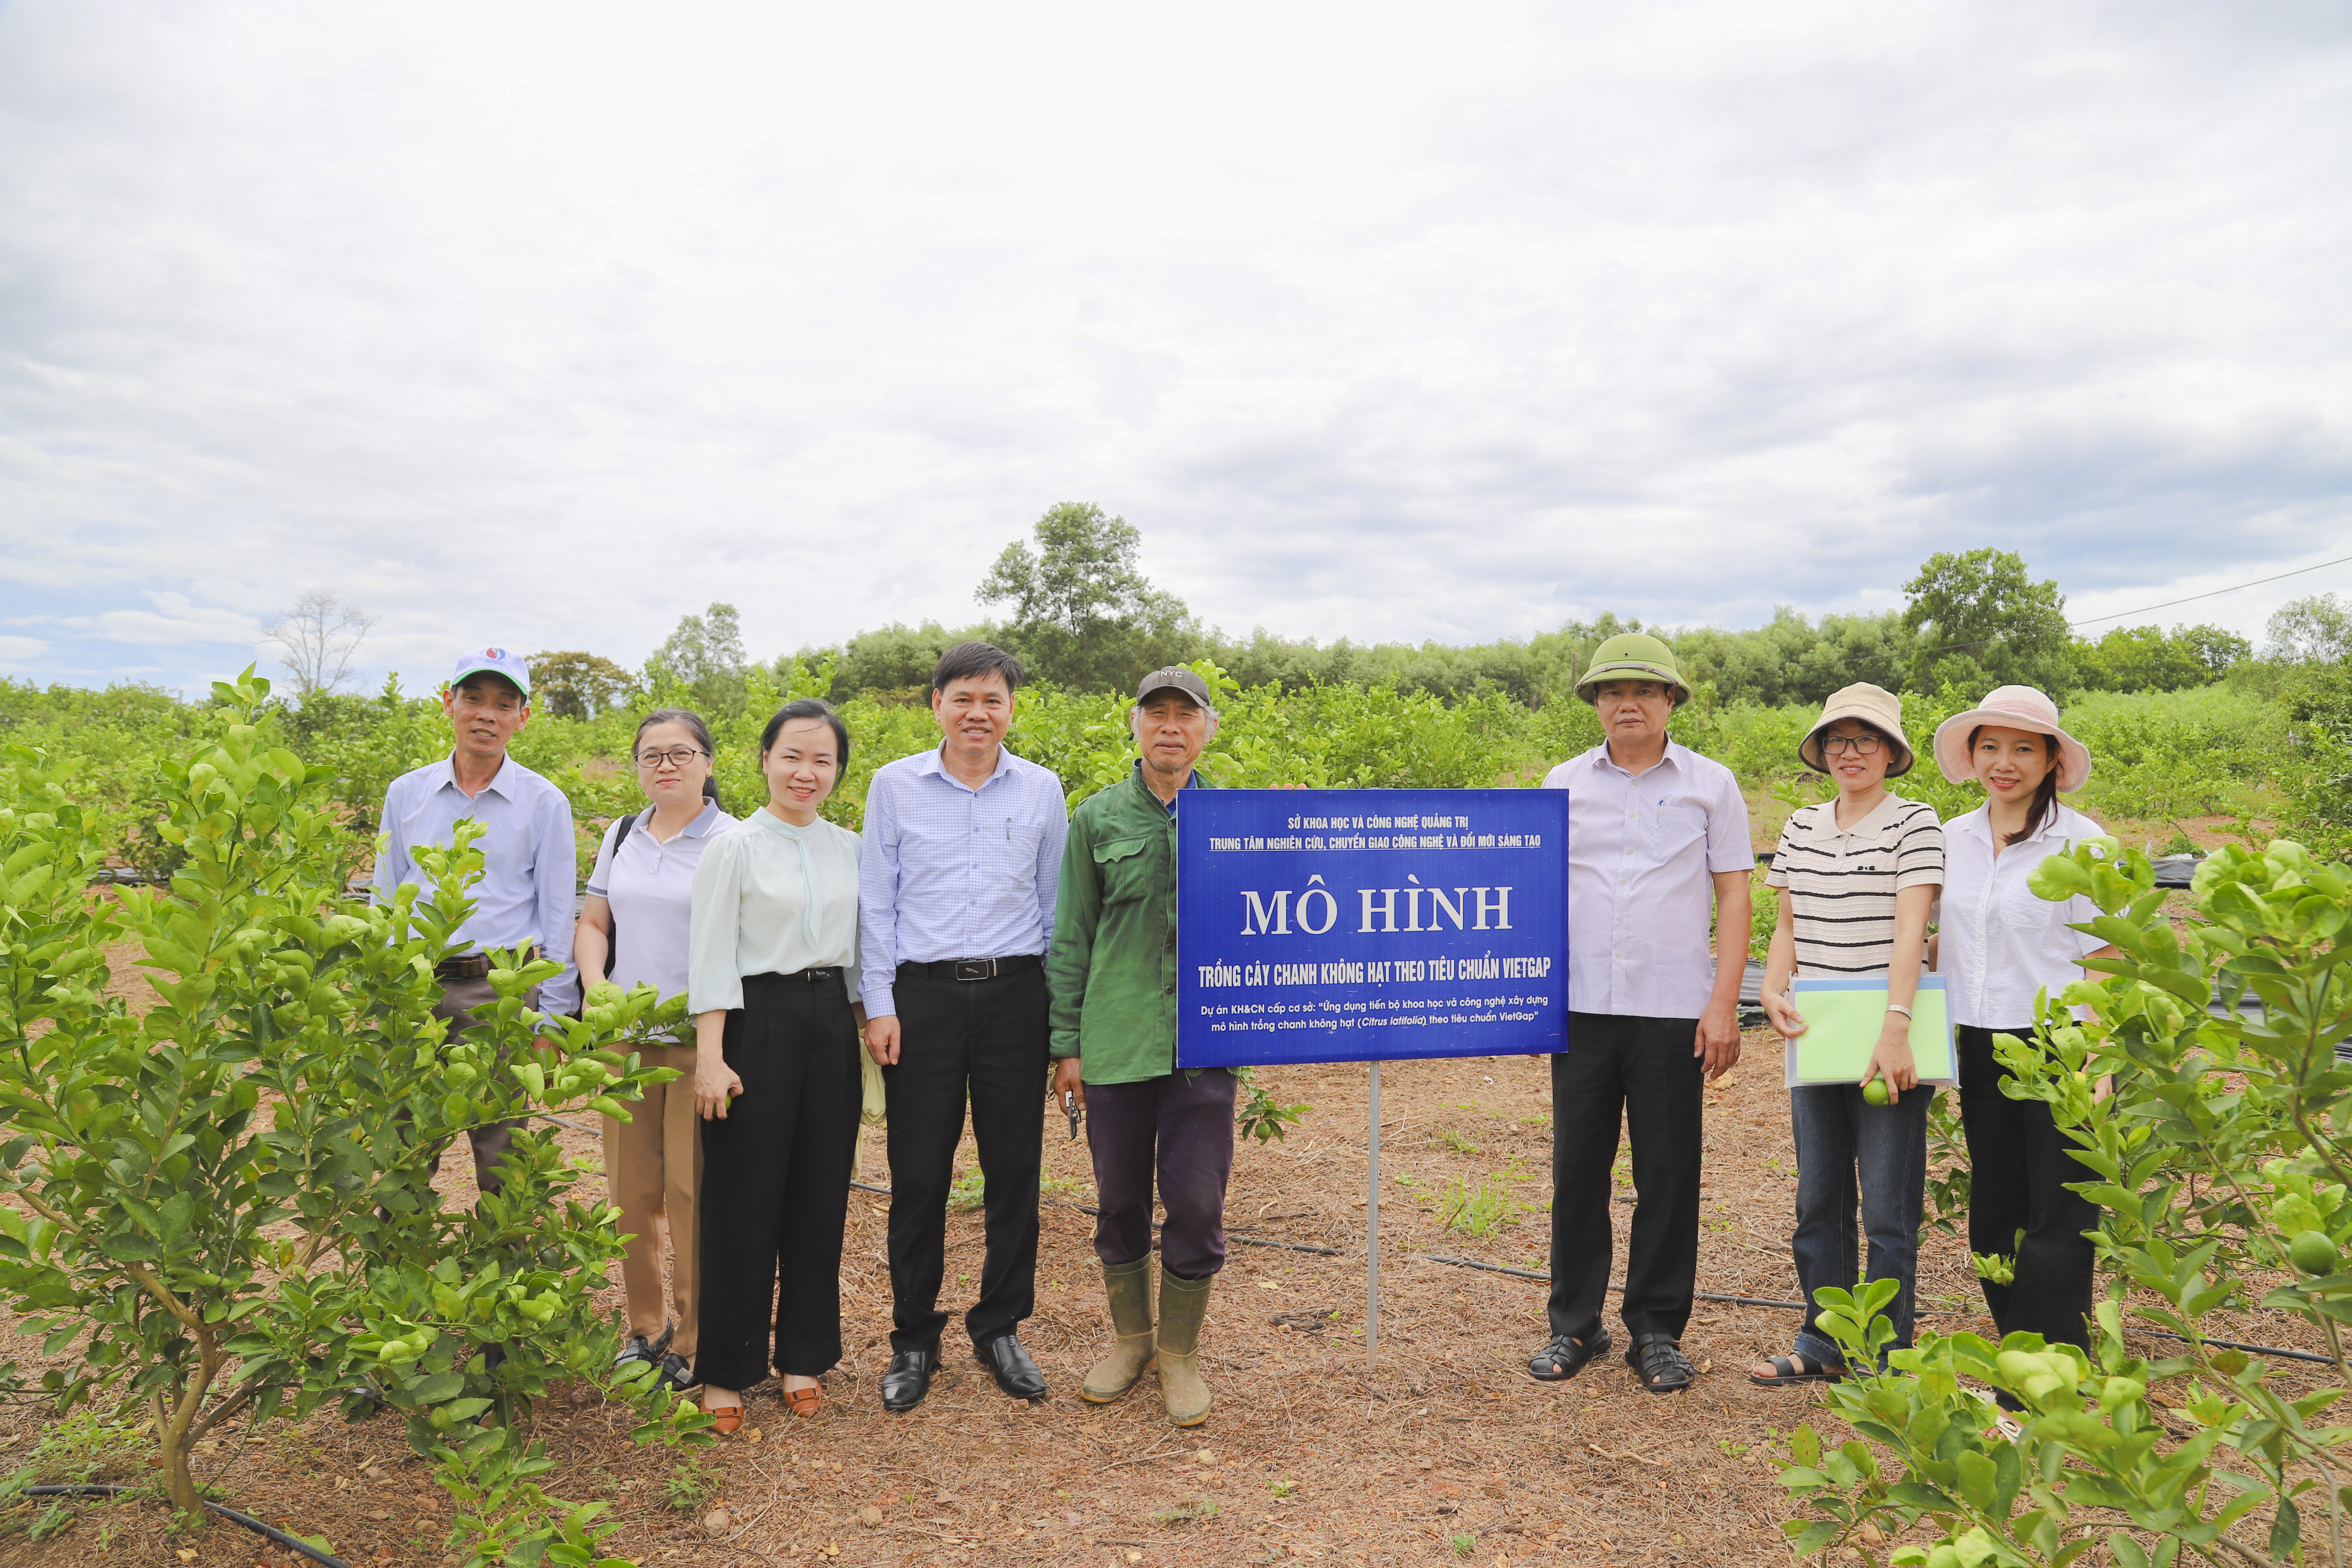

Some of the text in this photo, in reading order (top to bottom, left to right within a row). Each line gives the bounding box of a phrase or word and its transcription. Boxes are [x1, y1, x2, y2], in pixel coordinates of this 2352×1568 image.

[1288, 812, 1468, 831] SỞ KHOA HỌC VÀ CÔNG NGHỆ QUẢNG TRỊ
[1210, 831, 1540, 850] TRUNG TÂM NGHIÊN CỨU, CHUYỂN GIAO CÔNG NGHỆ VÀ ĐỔI MỚI SÁNG TẠO
[1240, 874, 1513, 935] MÔ HÌNH
[1198, 949, 1551, 988] TRỒNG CÂY CHANH KHÔNG HẠT THEO TIÊU CHUẨN VIETGAP
[1369, 998, 1386, 1009] tiến
[1389, 999, 1400, 1011] bộ
[1403, 1000, 1424, 1009] khoa
[1427, 999, 1444, 1010] học
[1446, 997, 1457, 1007] và
[1446, 997, 1457, 1007] công
[1484, 995, 1506, 1008] nghệ
[1508, 995, 1524, 1006] xây
[1527, 995, 1548, 1006] dựng
[1201, 1006, 1214, 1017] Dự
[1216, 1004, 1228, 1014] án
[1231, 1004, 1265, 1014] KH&CN
[1268, 1001, 1285, 1014] cấp
[1303, 1001, 1315, 1012] sở:
[1319, 1000, 1341, 1013] “Ứng
[1343, 1001, 1366, 1013] dụng
[1211, 1009, 1539, 1032] mô hình trồng chanh không hạt (Citrus latifolia) theo tiêu chuẩn VietGap”
